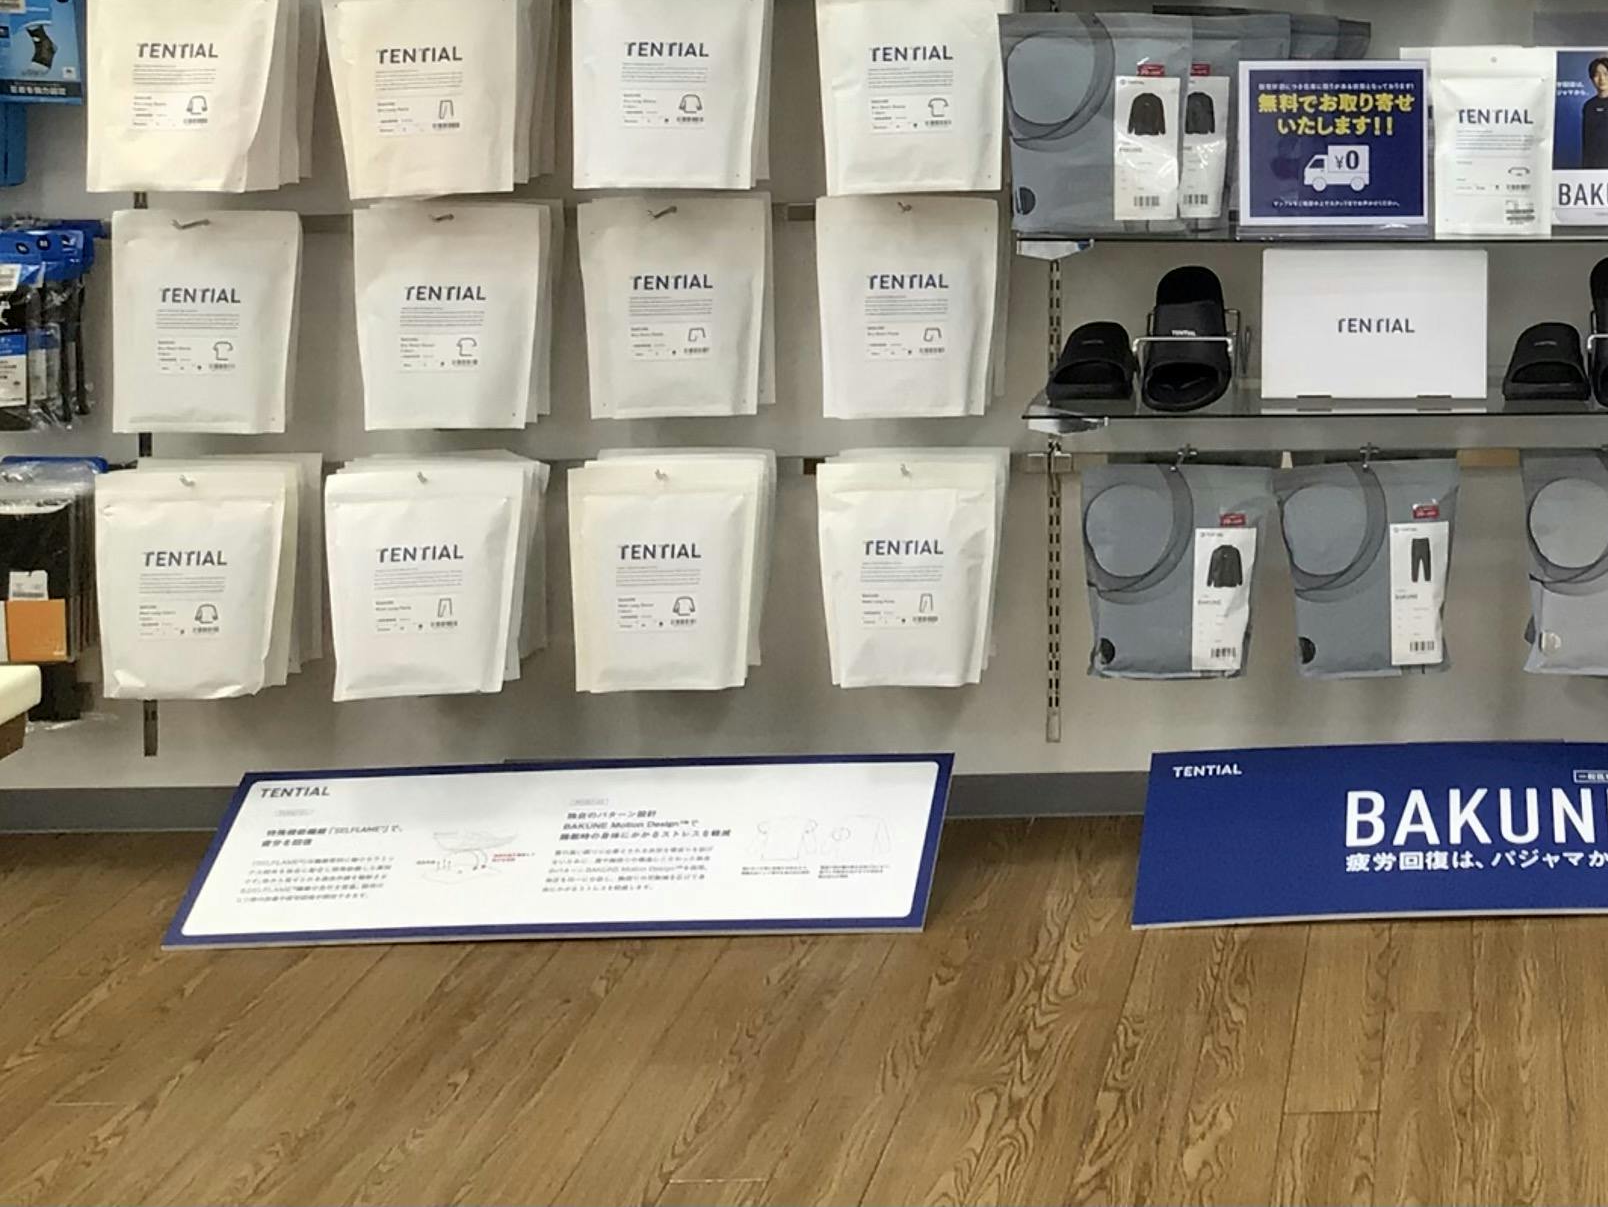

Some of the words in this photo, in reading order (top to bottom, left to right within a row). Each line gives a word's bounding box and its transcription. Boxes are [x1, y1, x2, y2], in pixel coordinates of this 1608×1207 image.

[136, 42, 219, 59] TENTIAL
[376, 45, 463, 65] TENTIAL
[625, 41, 710, 58] TENTIAL
[869, 44, 954, 63] TENTIAL
[1258, 93, 1415, 113] 無料でお取り寄せ
[1277, 116, 1394, 135] いたします!!
[1456, 108, 1534, 125] TENTIAL
[1335, 150, 1359, 170] ¥0
[630, 273, 714, 291] TENTIAL
[867, 273, 950, 290] TENTIAL
[159, 287, 241, 304] TENTIAL
[403, 285, 487, 302] TENTIAL
[1336, 316, 1416, 334] TENTIAL
[377, 543, 465, 564] TENTIAL
[618, 542, 702, 561] TENTIAL
[863, 539, 944, 556] TENTIAL
[142, 550, 228, 568] TENTIAL
[1172, 763, 1242, 778] TENTIAL
[260, 786, 331, 798] TENTIAL
